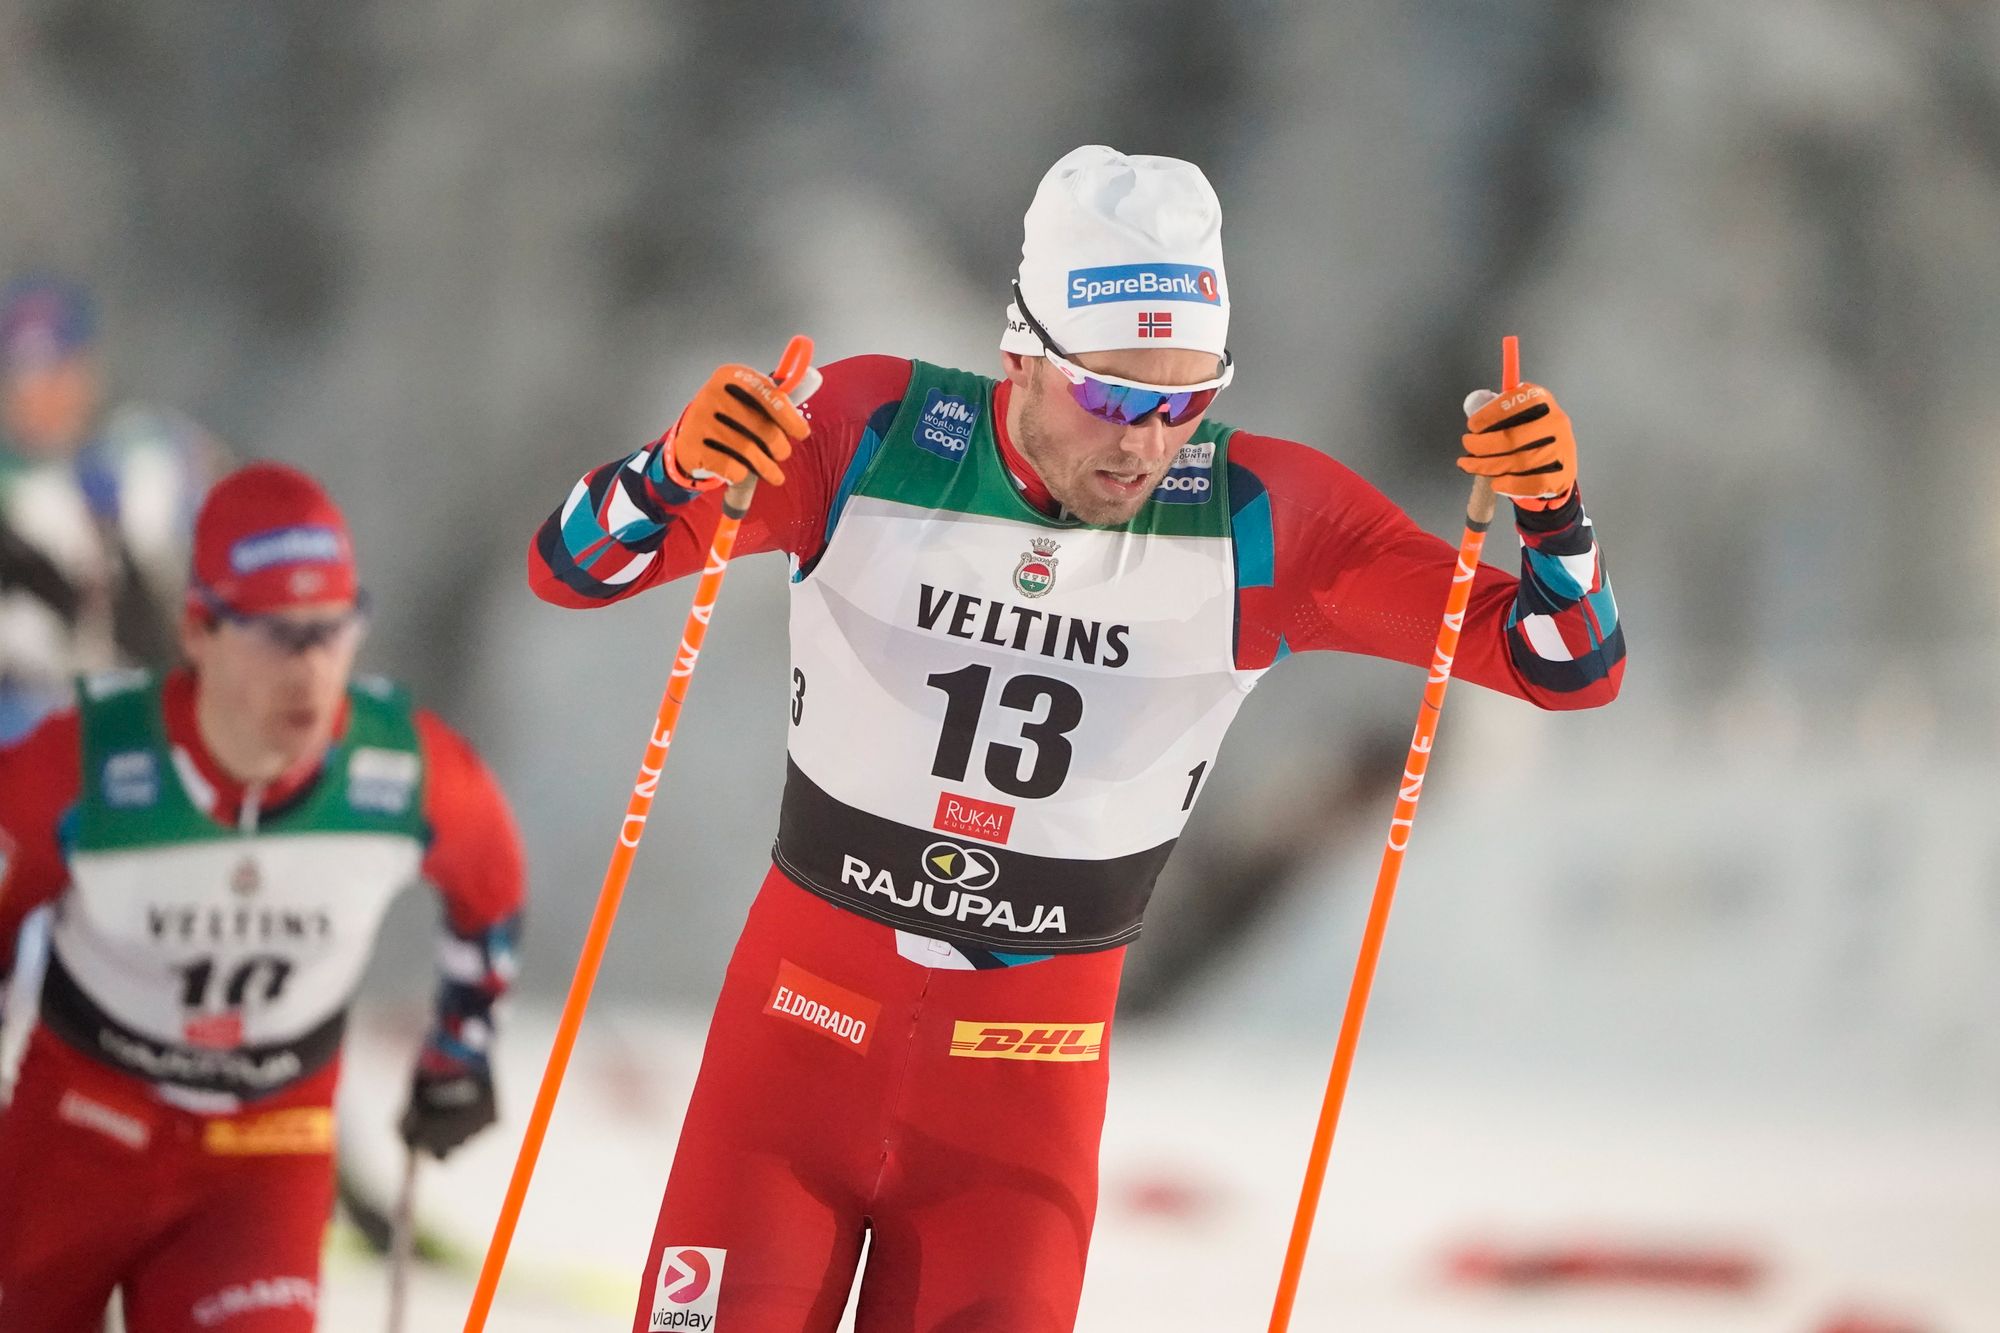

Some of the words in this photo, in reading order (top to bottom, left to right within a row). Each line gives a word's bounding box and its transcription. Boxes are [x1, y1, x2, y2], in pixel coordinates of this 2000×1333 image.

[1072, 272, 1198, 302] SpareBank
[1008, 320, 1034, 335] AFT
[924, 414, 954, 432] WORLD
[924, 428, 966, 452] coop
[1157, 476, 1210, 494] oop
[917, 583, 1130, 669] VELTINS
[792, 667, 806, 727] 3
[927, 663, 1083, 800] 13
[1181, 760, 1208, 811] 1
[944, 820, 999, 837] KUUSAMO
[946, 800, 1003, 830] RUKA!
[840, 853, 1067, 934] RAJUPAJA
[772, 986, 867, 1045] ELDORADO
[974, 1028, 1085, 1055] DHL
[653, 1307, 713, 1332] viaplay
